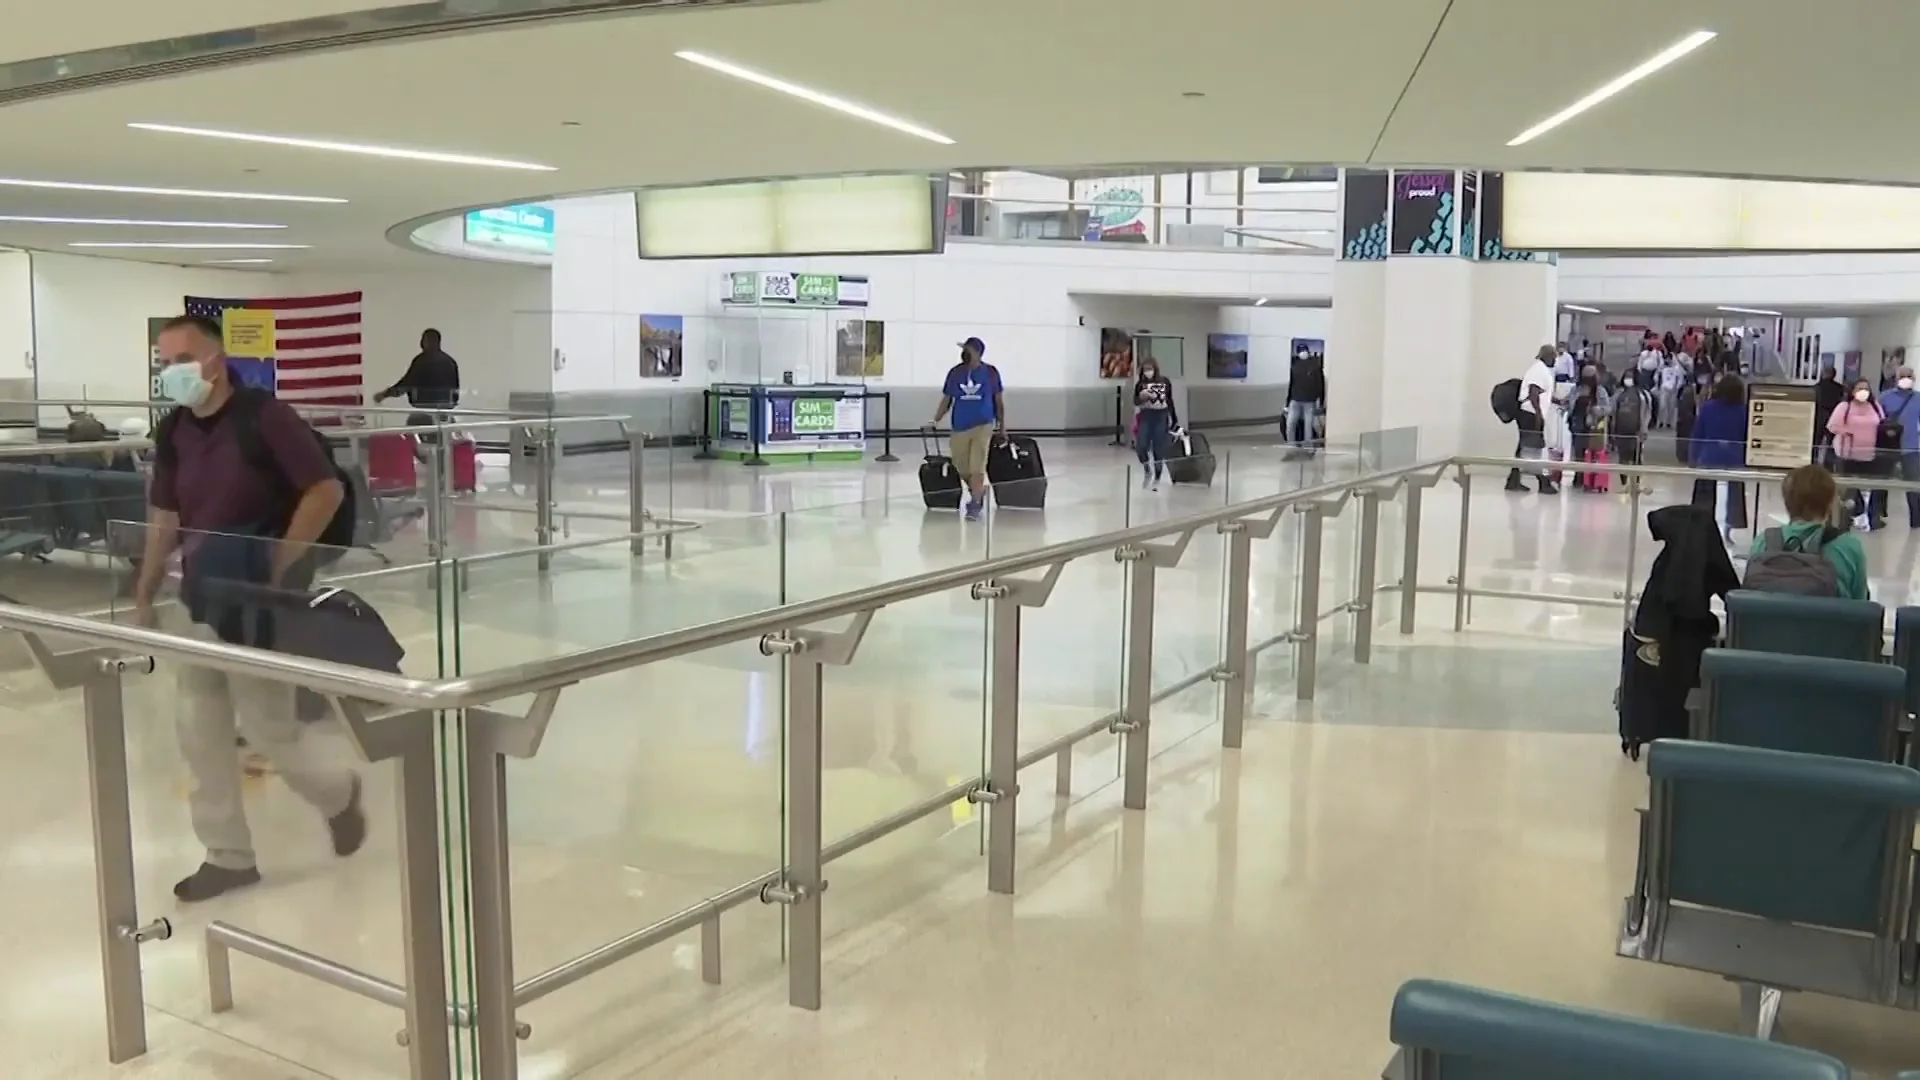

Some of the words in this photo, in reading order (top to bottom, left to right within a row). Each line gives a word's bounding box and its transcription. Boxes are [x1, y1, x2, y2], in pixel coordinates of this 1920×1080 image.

[1409, 186, 1435, 199] proud
[766, 275, 790, 286] SIMS
[803, 276, 822, 286] SIM
[800, 285, 834, 295] CARDS
[798, 401, 821, 414] SIM
[795, 414, 833, 427] CARDS
